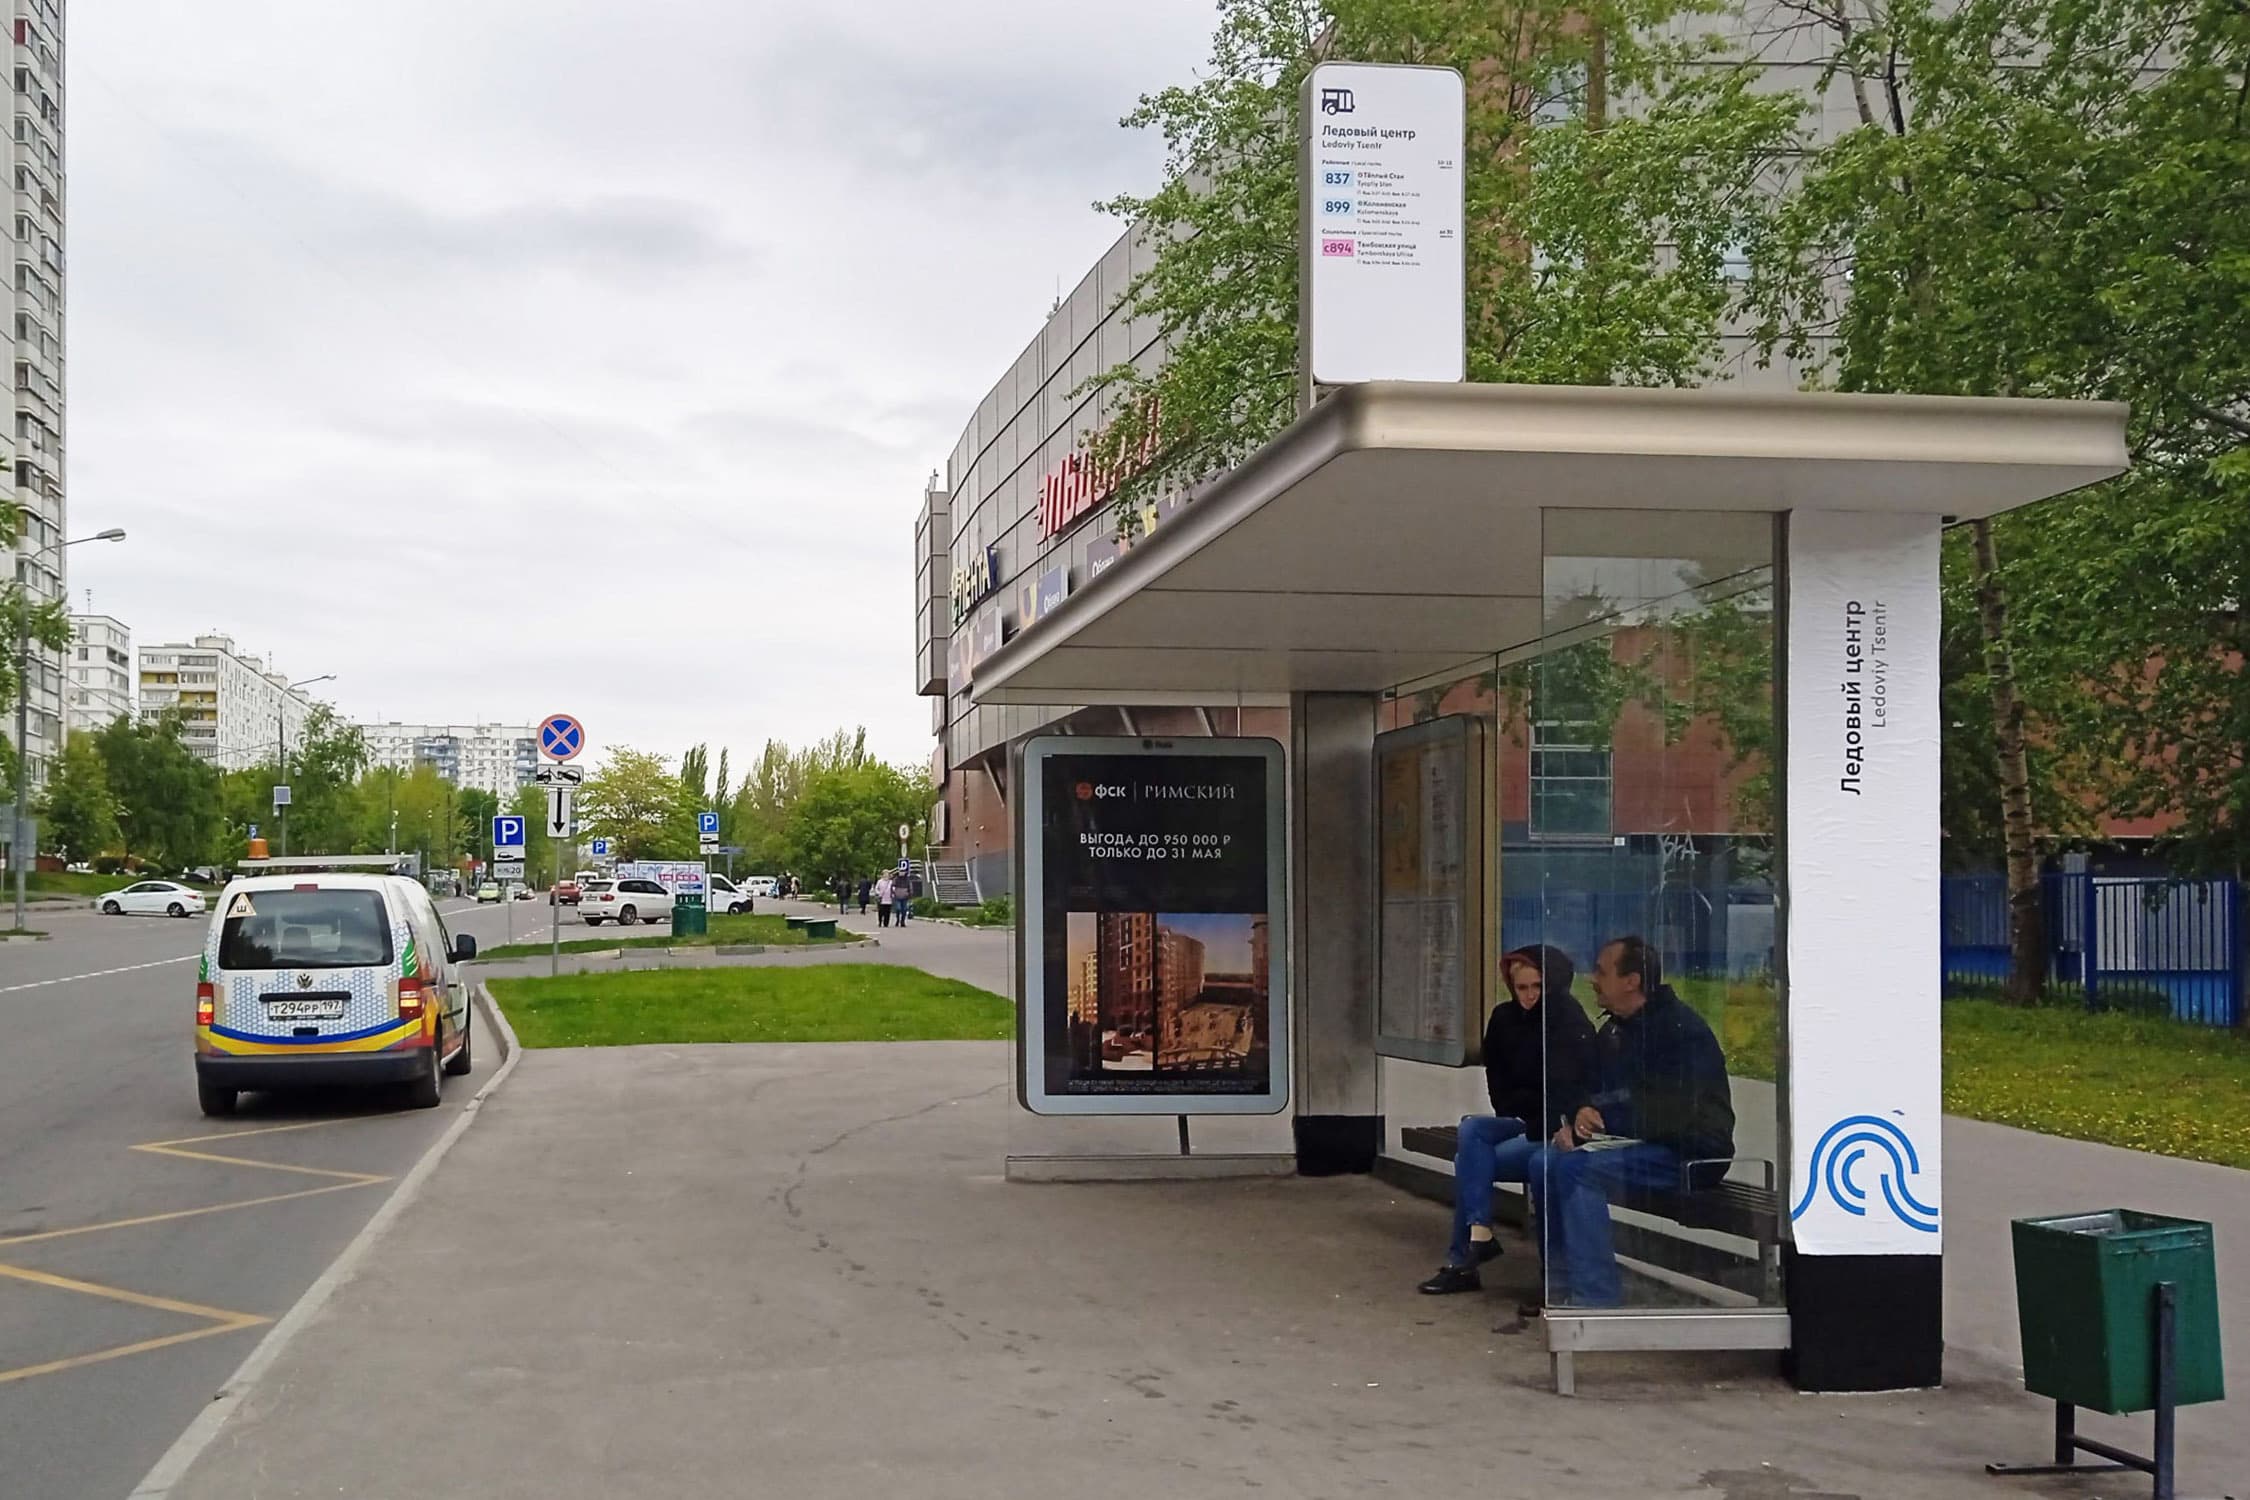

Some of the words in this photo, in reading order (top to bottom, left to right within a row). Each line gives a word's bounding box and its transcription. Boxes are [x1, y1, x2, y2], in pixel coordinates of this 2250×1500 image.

[1322, 124, 1378, 138] Ледовый
[1380, 128, 1416, 141] центр
[1356, 141, 1382, 150] Tsentr
[1325, 172, 1350, 184] 837
[1325, 201, 1350, 213] 899
[1324, 242, 1352, 254] с894
[1871, 601, 1887, 654] Tsentr
[1846, 600, 1866, 673] центр
[1870, 660, 1889, 728] Ledoviy
[1841, 681, 1864, 795] Ледовый
[1144, 783, 1236, 799] РИМСКИЙ
[703, 815, 715, 831] P
[502, 819, 519, 844] P
[1080, 833, 1134, 846] ВЫГОДА
[1138, 834, 1159, 846] ДО
[1163, 834, 1188, 845] 950
[1192, 834, 1218, 845] 000
[595, 841, 604, 853] P
[1089, 847, 1142, 859] ТОЛЬКО
[1146, 848, 1167, 860] ДО
[1171, 848, 1185, 859] 31
[1191, 848, 1222, 859] МАЯ
[236, 904, 247, 912] Ш
[321, 1001, 340, 1010] 197
